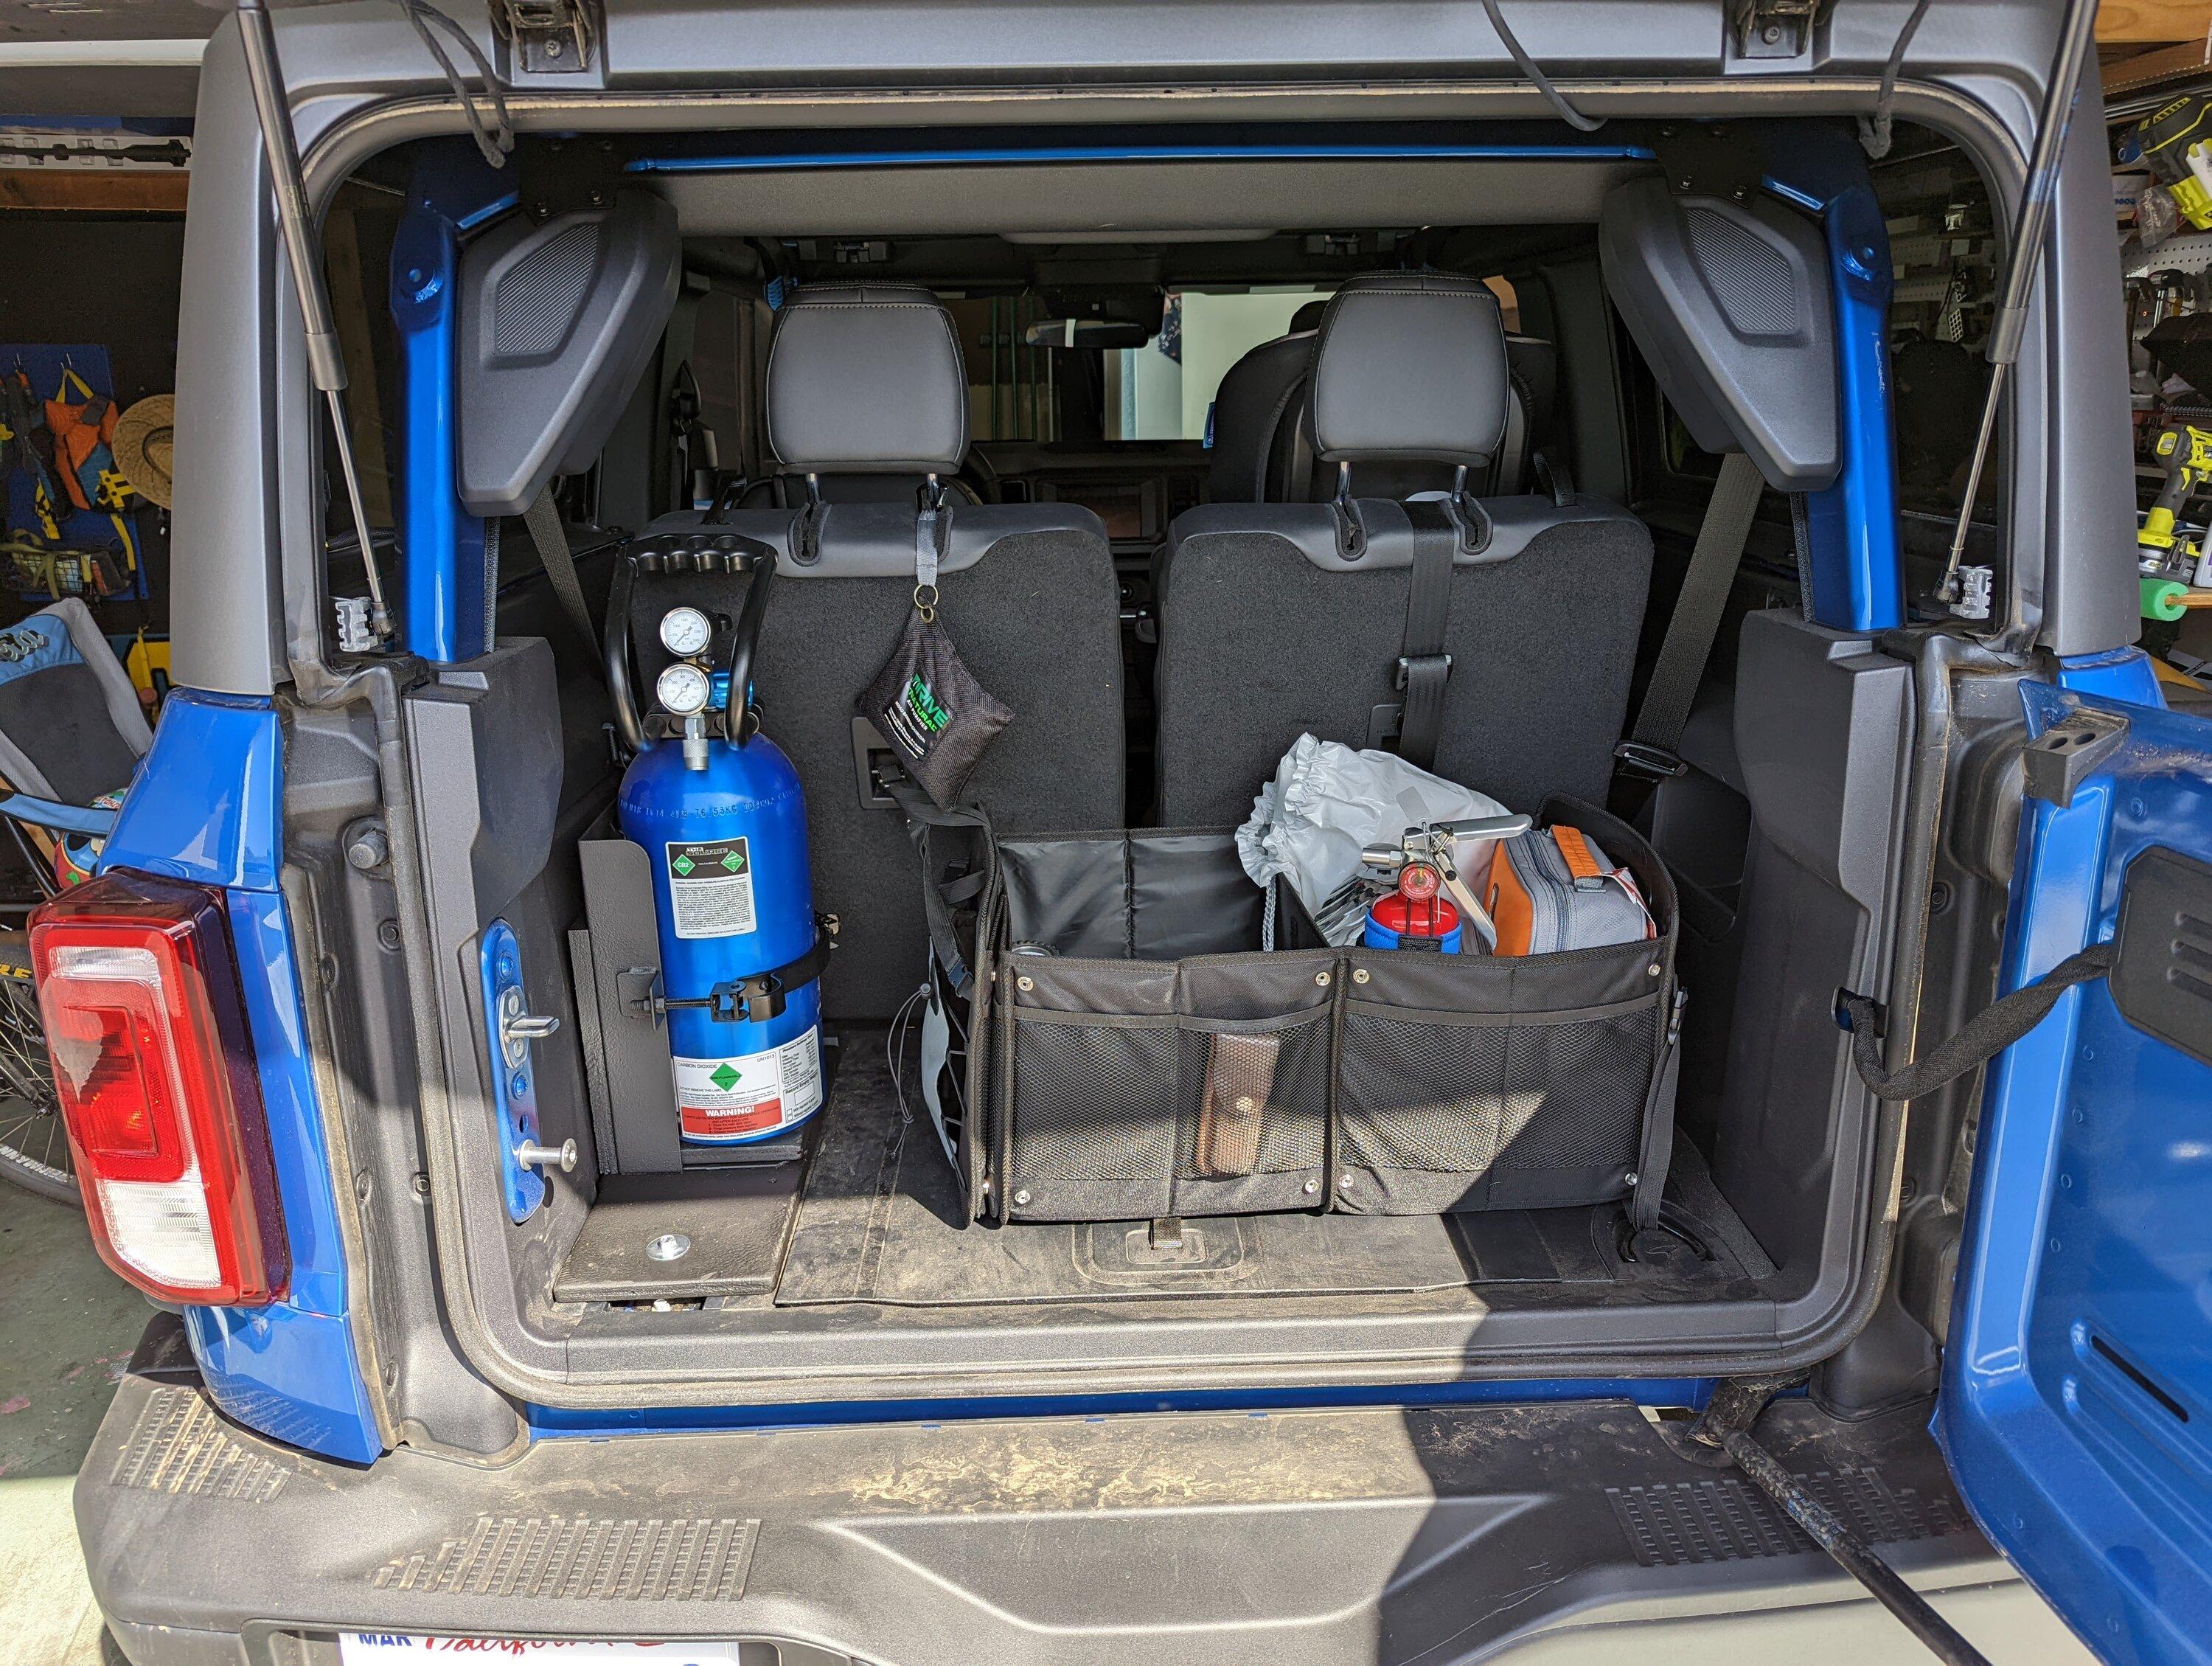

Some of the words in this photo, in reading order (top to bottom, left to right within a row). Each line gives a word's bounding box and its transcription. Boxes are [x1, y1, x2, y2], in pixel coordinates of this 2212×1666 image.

[911, 709, 928, 731] PURIFIER
[686, 847, 728, 856] SOURCE
[785, 1085, 799, 1094] Record
[800, 1079, 809, 1088] Empty
[705, 1106, 755, 1117] WARNING!
